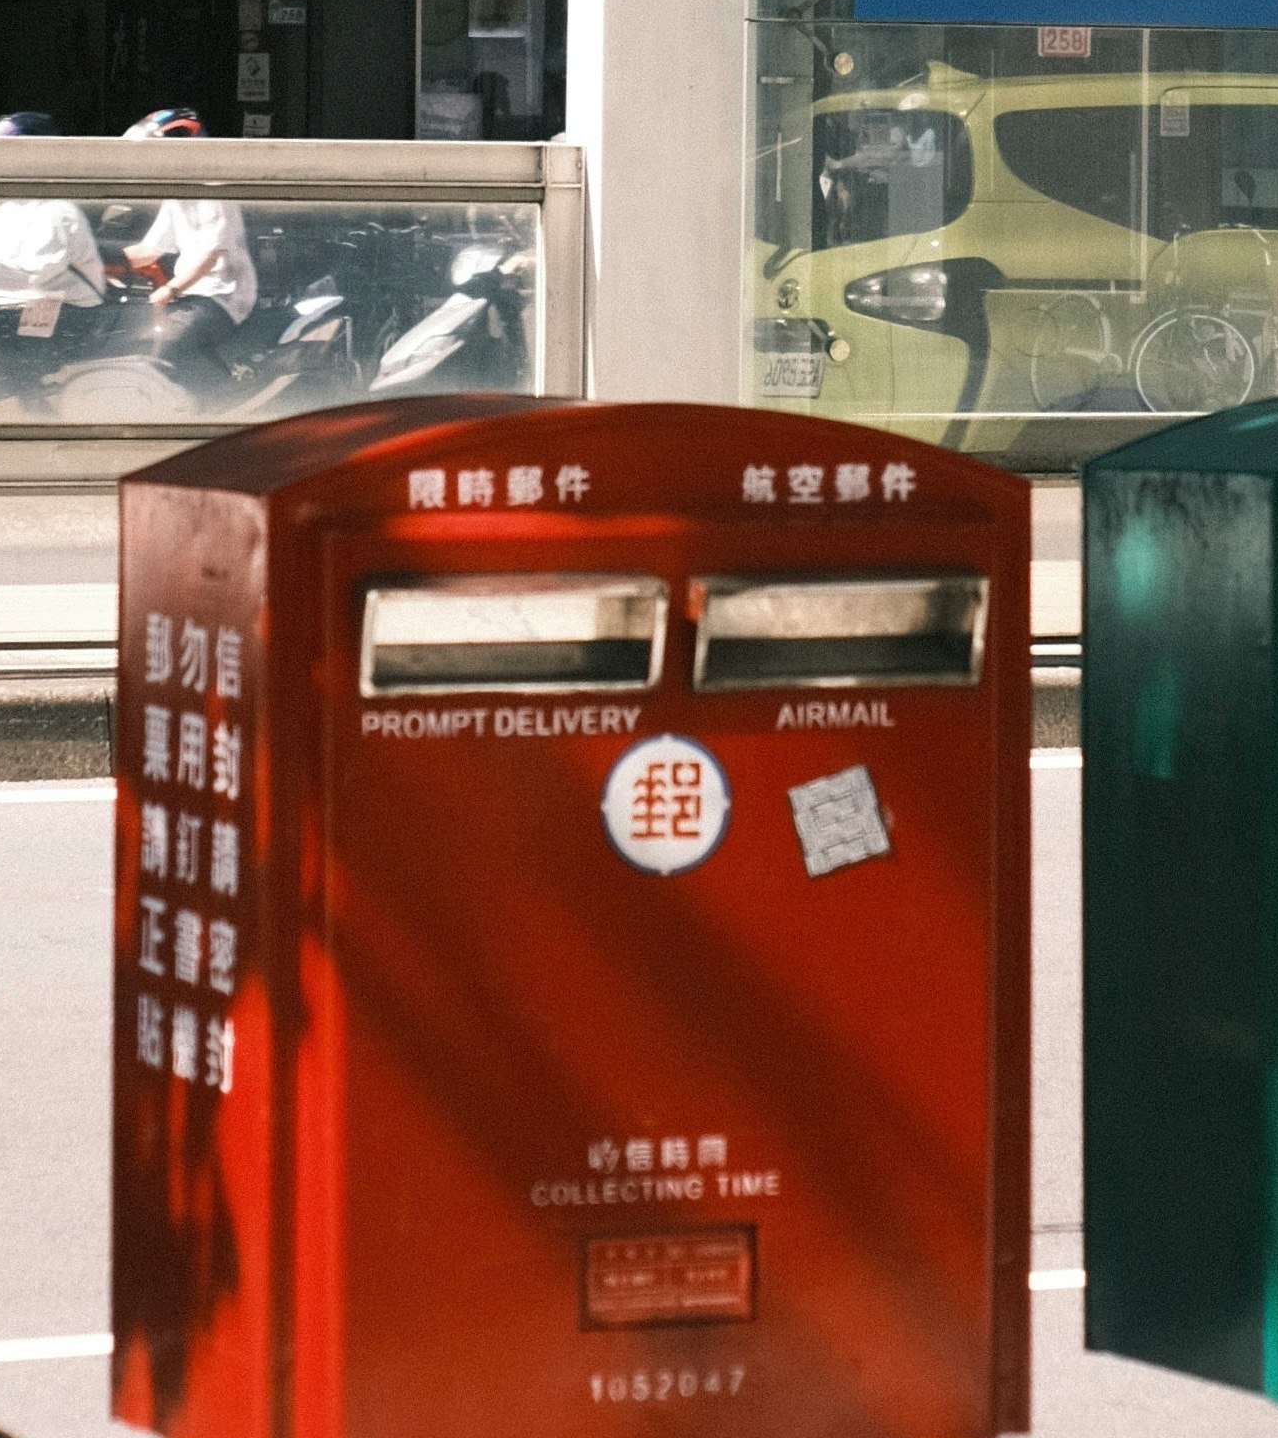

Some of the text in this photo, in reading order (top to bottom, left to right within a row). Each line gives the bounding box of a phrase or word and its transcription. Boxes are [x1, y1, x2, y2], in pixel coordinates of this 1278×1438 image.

[1045, 28, 1083, 52] 258
[406, 464, 593, 508] 限時郵件
[741, 459, 918, 504] 航空郵件
[360, 703, 642, 739] PROMPT DELIVERY
[775, 699, 896, 731] AIRMAIL
[530, 1170, 782, 1207] COLLECTING TIME
